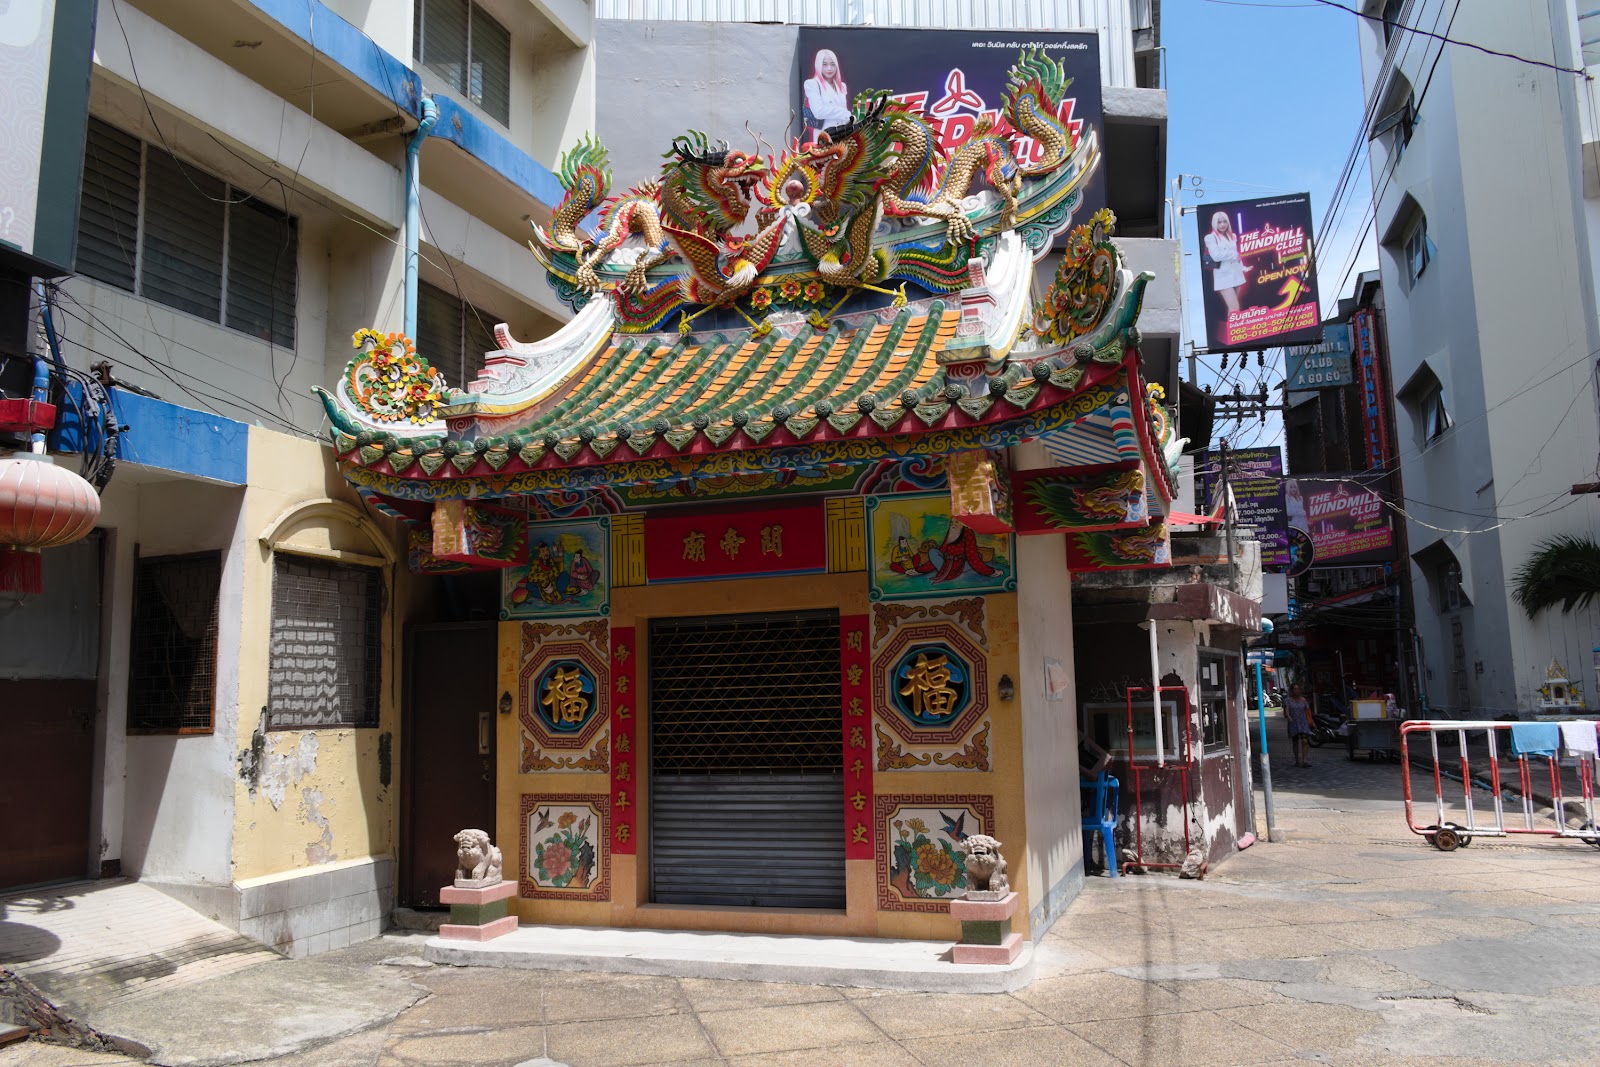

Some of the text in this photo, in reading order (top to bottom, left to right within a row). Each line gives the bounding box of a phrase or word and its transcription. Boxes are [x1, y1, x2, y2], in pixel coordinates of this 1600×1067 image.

[1239, 231, 1260, 243] THE
[1239, 227, 1304, 253] WINDMILL
[1275, 238, 1303, 251] CLUB
[1257, 264, 1308, 284] OPEN NOW
[1289, 341, 1344, 357] WINDMILL
[1304, 357, 1333, 369] CLUB
[1298, 375, 1305, 385] A
[1361, 355, 1382, 456] WINDMILL
[1309, 490, 1381, 517] WINDMILL
[1310, 492, 1331, 505] THE
[1350, 503, 1380, 517] CLUB
[900, 653, 958, 717] 福
[541, 667, 589, 724] 福
